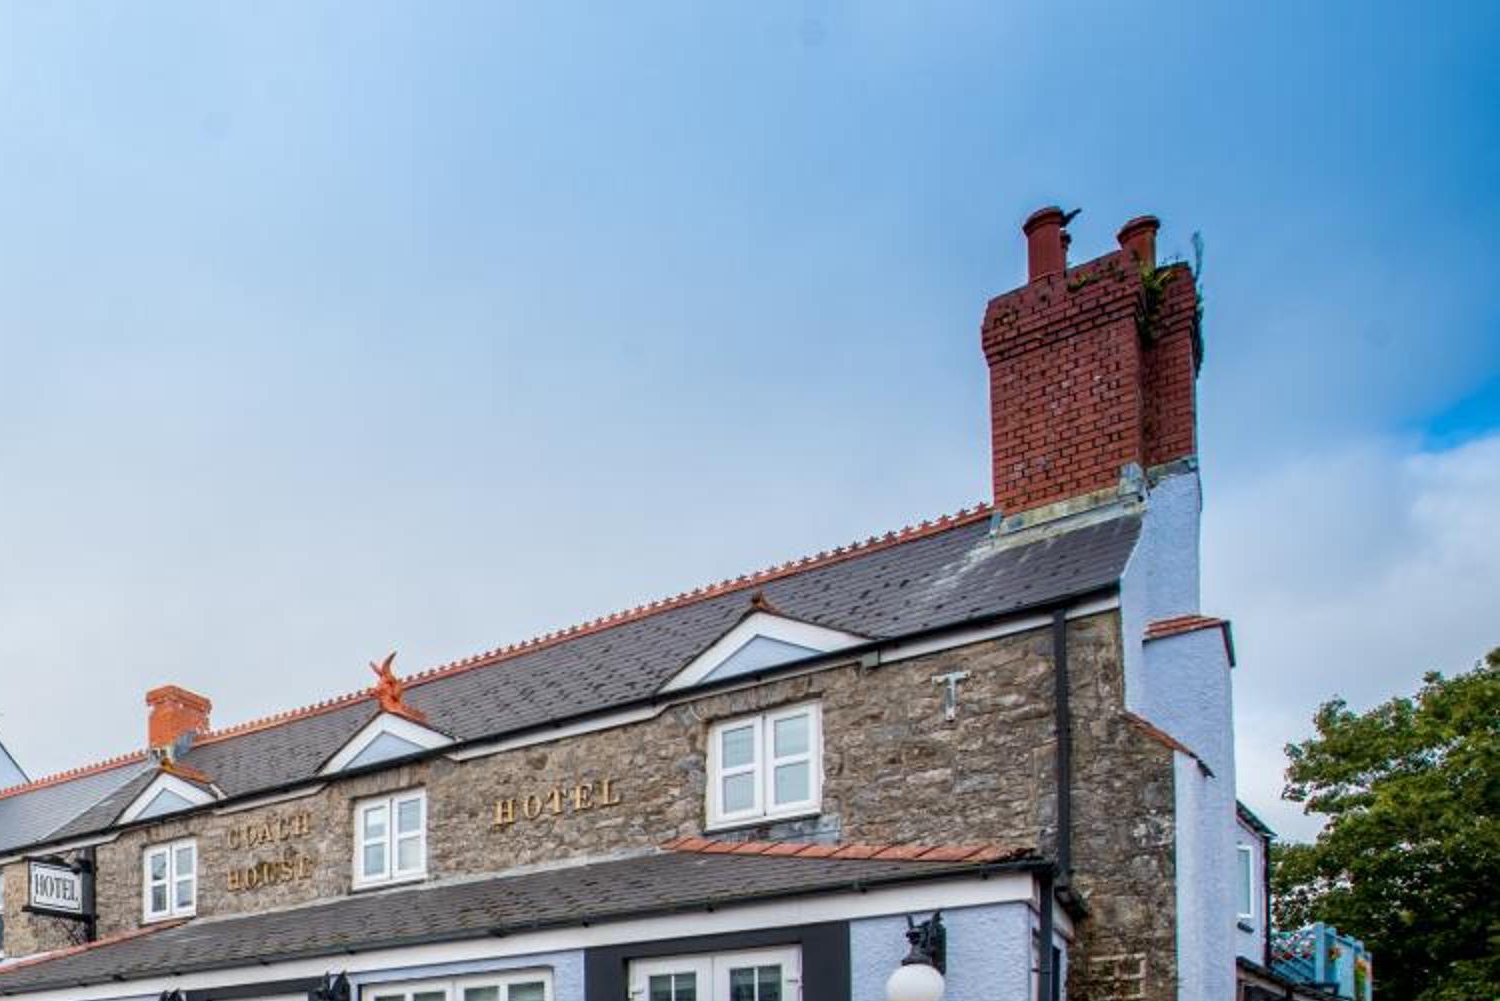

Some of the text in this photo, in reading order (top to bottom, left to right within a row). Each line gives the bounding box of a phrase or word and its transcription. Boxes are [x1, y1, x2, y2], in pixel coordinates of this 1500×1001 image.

[492, 778, 621, 826] HOTEL
[227, 811, 311, 850] COACH
[35, 873, 78, 901] HOTEL
[226, 856, 312, 893] HOUSE
